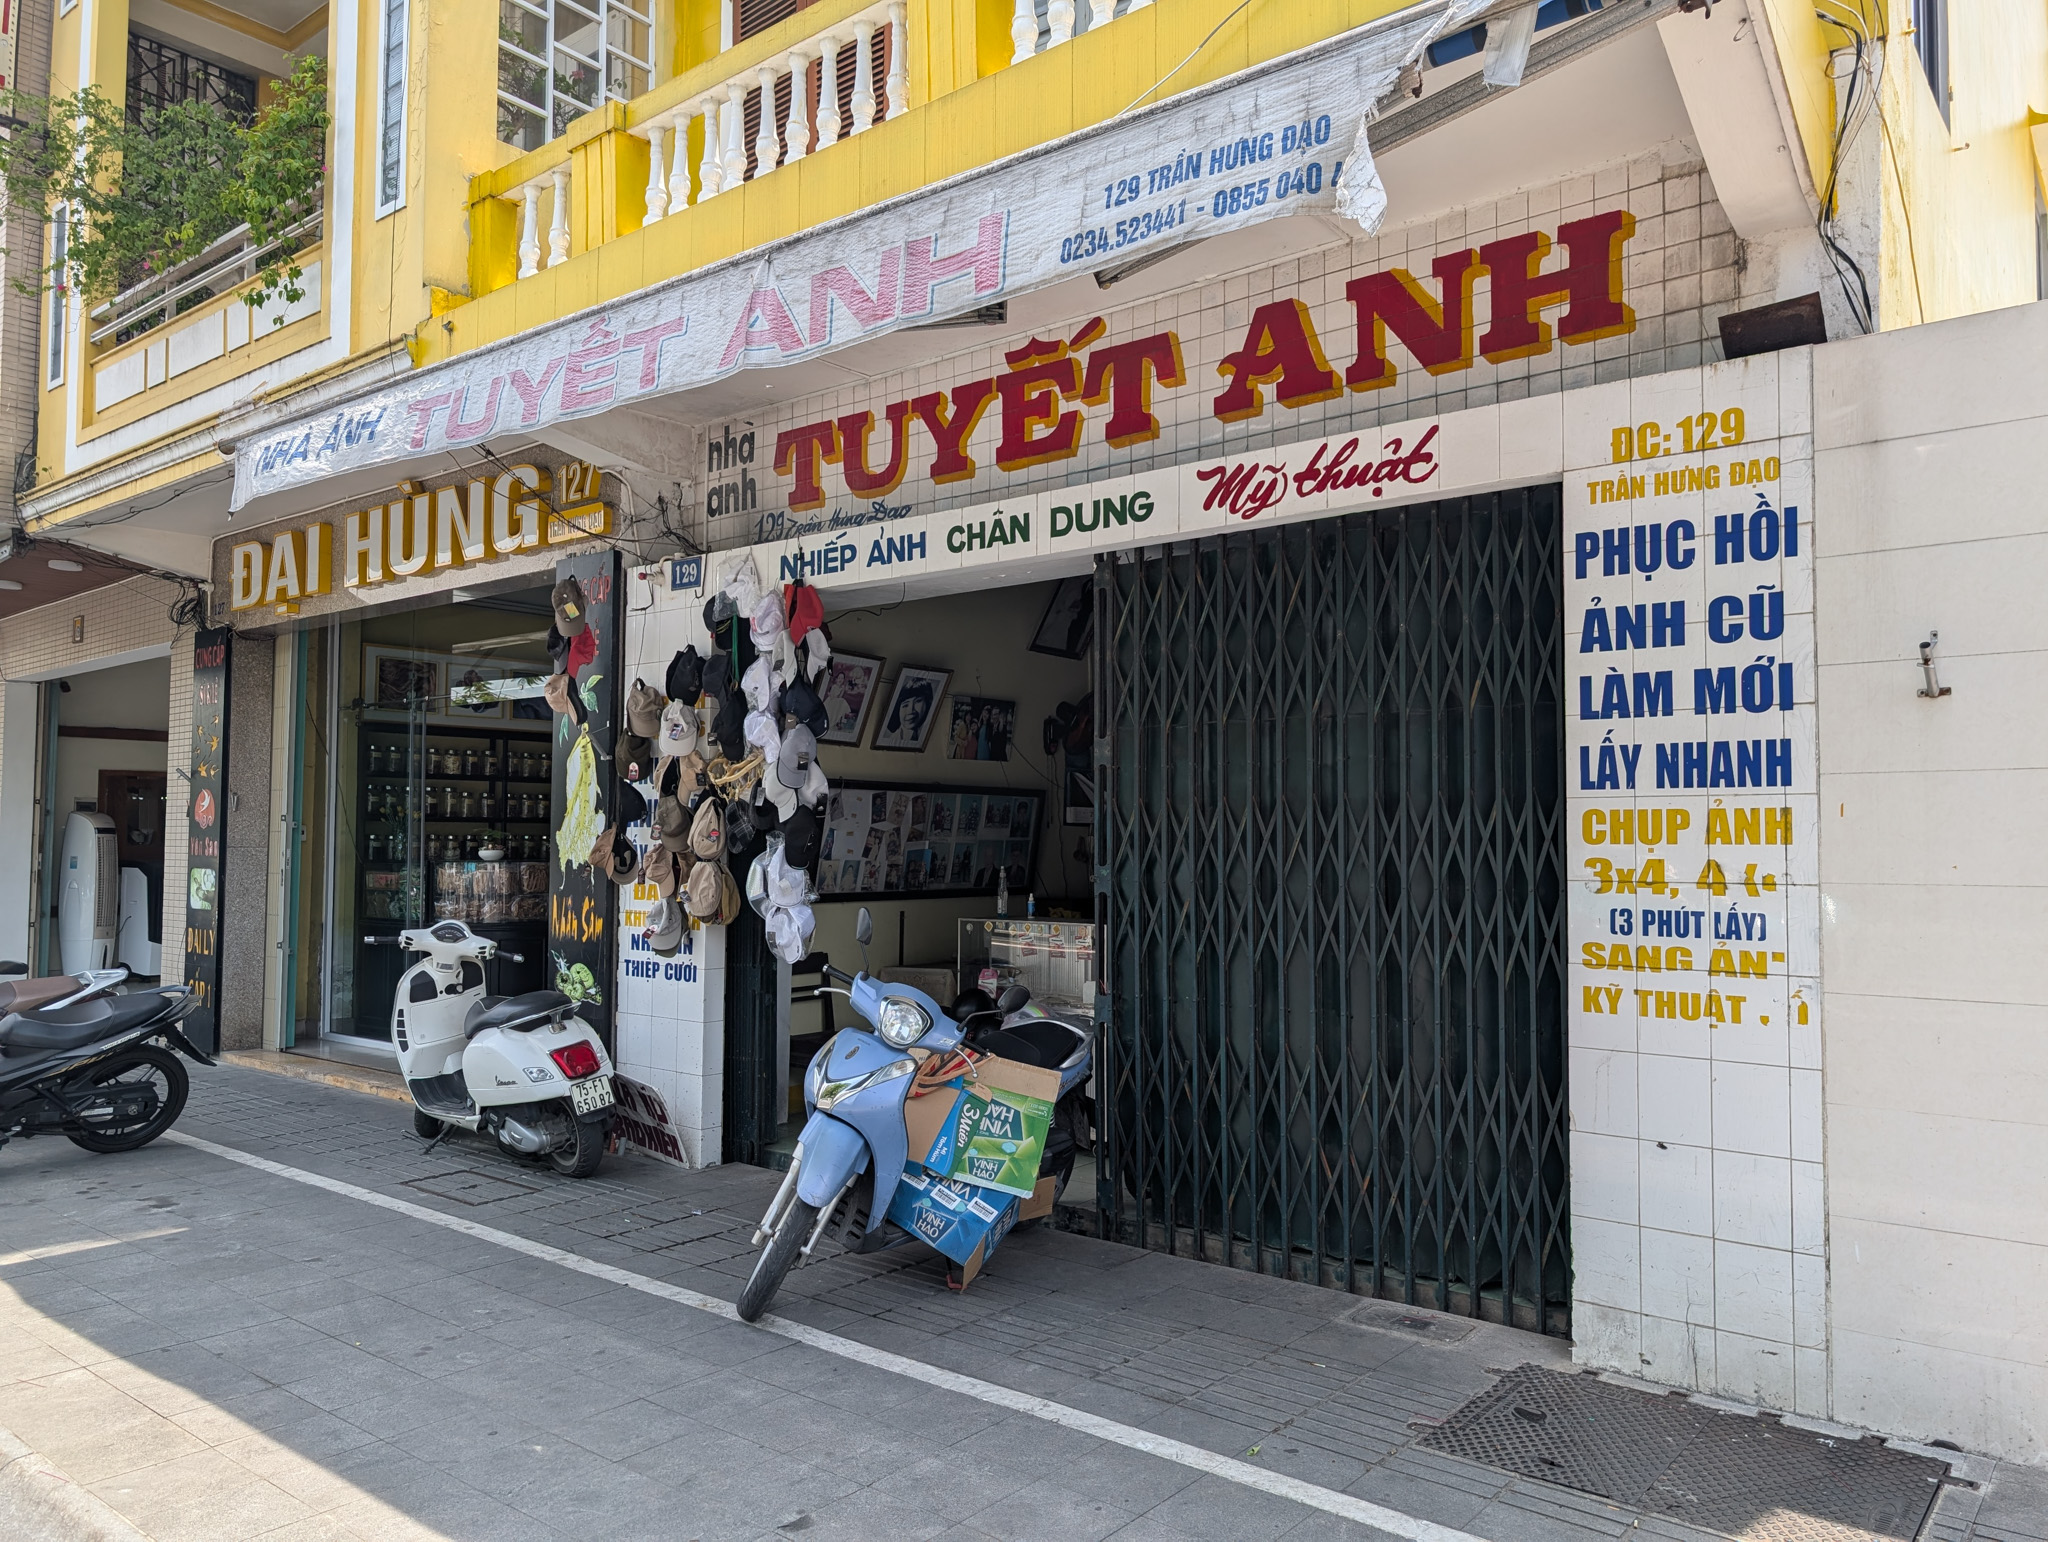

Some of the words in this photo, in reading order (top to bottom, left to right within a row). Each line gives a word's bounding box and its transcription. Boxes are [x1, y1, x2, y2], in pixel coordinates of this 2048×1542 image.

[1104, 175, 1140, 209] 129
[1147, 148, 1202, 195] TRẦN
[1208, 132, 1274, 176] HƯNG
[1280, 114, 1332, 155] ĐẠO
[1060, 199, 1187, 264] 0234.523441
[1212, 178, 1271, 218] 0855
[1275, 162, 1323, 199] 040
[254, 425, 313, 477] NHÀ
[315, 407, 388, 461] ẢNH
[407, 313, 689, 450] TUYẾT
[716, 209, 1009, 371] ANH
[773, 317, 1187, 512] TUYẾT
[1214, 210, 1636, 424] ANH
[708, 420, 755, 473] nhà
[558, 460, 597, 504] 127
[707, 467, 757, 518] ảnh
[780, 532, 858, 582] NHIẾP
[866, 526, 927, 568] ẢNH
[946, 508, 1031, 554] CHÂN
[1050, 490, 1155, 538] DUNG
[1196, 461, 1288, 520] Mỹ
[1293, 424, 1440, 498] thuật
[1587, 469, 1646, 505] TRẦN
[1654, 464, 1721, 497] HƯNG
[1729, 456, 1781, 489] ĐẠO
[229, 522, 332, 616] ĐẠI
[344, 464, 552, 588] HÙNG
[752, 510, 785, 545] 129
[1575, 519, 1696, 582] PHỤC
[1714, 493, 1799, 566] HỒI
[675, 562, 698, 585] 129
[1579, 596, 1686, 654] ẢNH
[1708, 584, 1785, 644] CŨ
[196, 646, 212, 669] CUNG
[1579, 666, 1675, 721] LÀM
[1693, 655, 1795, 715] MỚI
[1579, 728, 1643, 791] LẤY
[1655, 738, 1793, 789] NHANH
[1581, 807, 1691, 853] CHỤP
[1704, 798, 1794, 846] ẢNH
[1583, 857, 1680, 899] 3x4,
[551, 894, 578, 941] Nhân
[582, 896, 604, 943] Sâm
[1609, 908, 1634, 936] (3
[1641, 905, 1706, 939] PHÚT
[1713, 902, 1768, 942] LẤY)
[624, 957, 660, 983] THIỆP
[664, 959, 698, 983] CƯỚI
[1581, 941, 1694, 974] SANG
[1582, 983, 1624, 1016] KỸ
[1633, 989, 1747, 1029] THUẬT
[494, 1075, 519, 1087] Vespa
[576, 1078, 606, 1098] 75-F1
[576, 1091, 613, 1114] 650.82
